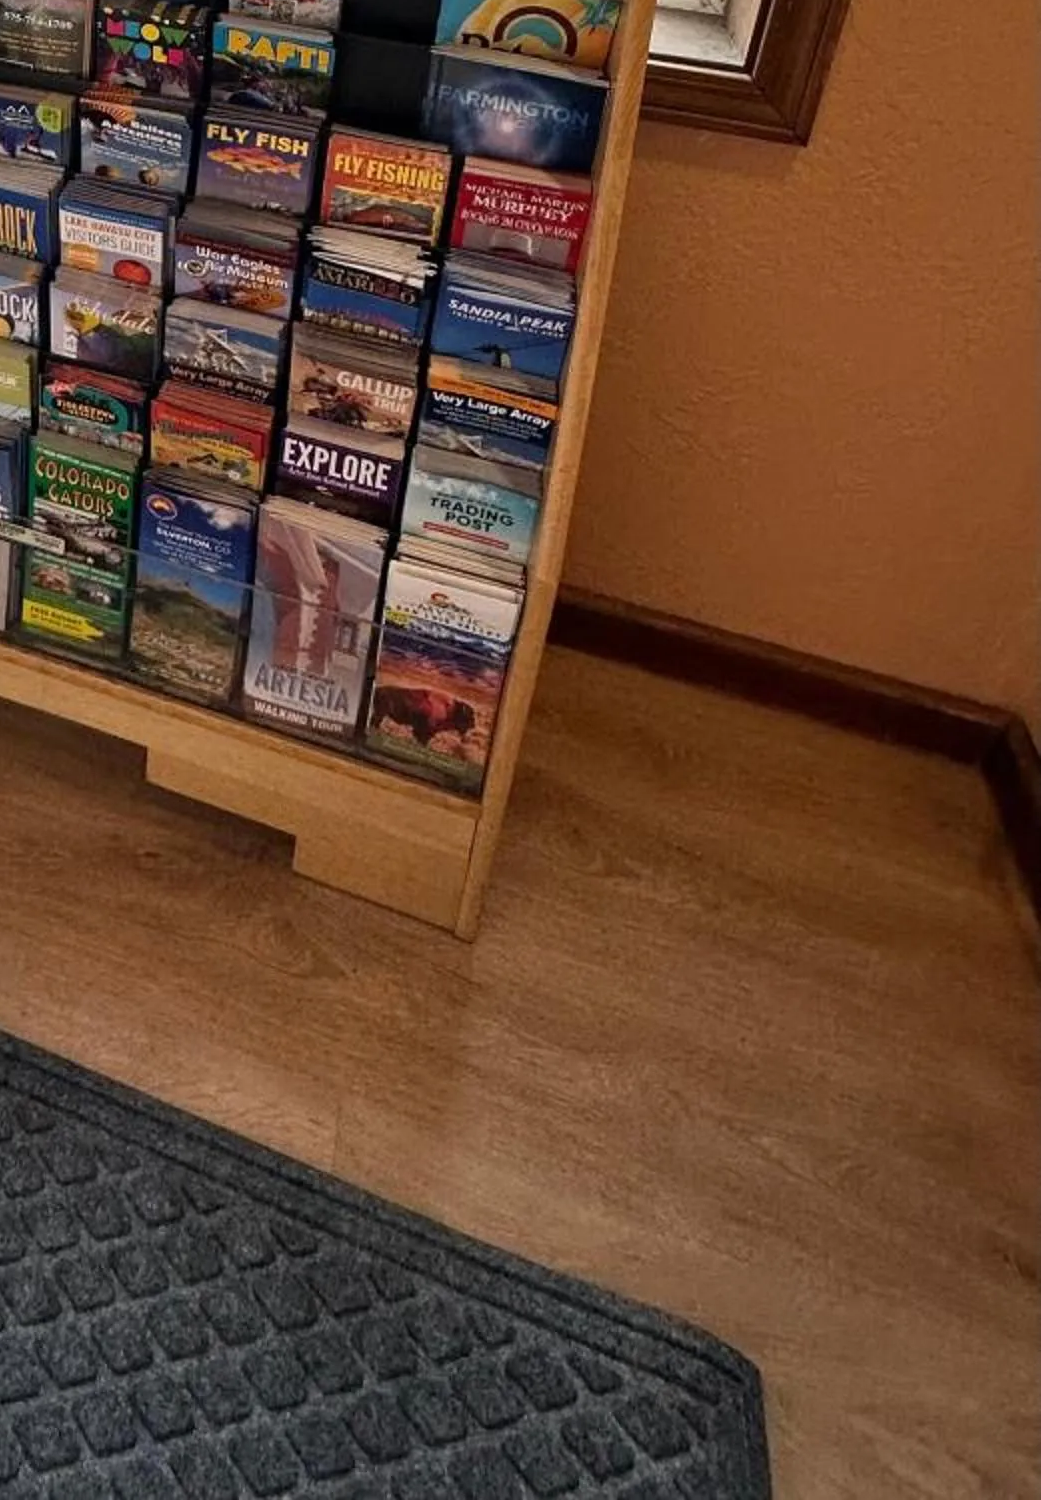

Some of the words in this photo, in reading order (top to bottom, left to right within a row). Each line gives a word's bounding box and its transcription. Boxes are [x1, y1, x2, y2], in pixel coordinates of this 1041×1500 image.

[228, 28, 331, 74] RAFT!
[438, 85, 591, 128] FARMINGTON
[206, 122, 251, 145] FLY
[256, 131, 309, 157] FISH
[334, 152, 365, 176] FLY
[365, 158, 445, 192] FISHING
[465, 182, 527, 202] MICHAEL
[529, 194, 589, 212] MARTIN
[195, 244, 228, 262] War
[230, 253, 282, 275] Eagles
[225, 264, 290, 290] Museum
[448, 299, 513, 323] SANDIA
[519, 315, 569, 334] PEAK
[169, 364, 197, 381] Very
[336, 369, 416, 401] GALLUP
[432, 390, 464, 408] Very
[467, 398, 508, 416] Large
[510, 409, 551, 429] Array
[35, 455, 130, 501] COLORADO
[282, 437, 392, 492] EXPLORE
[48, 483, 114, 518] GATORS
[430, 497, 516, 528] TRADING
[444, 511, 496, 534] POST
[254, 663, 351, 716] ARTESIA
[254, 700, 308, 726] WALKING
